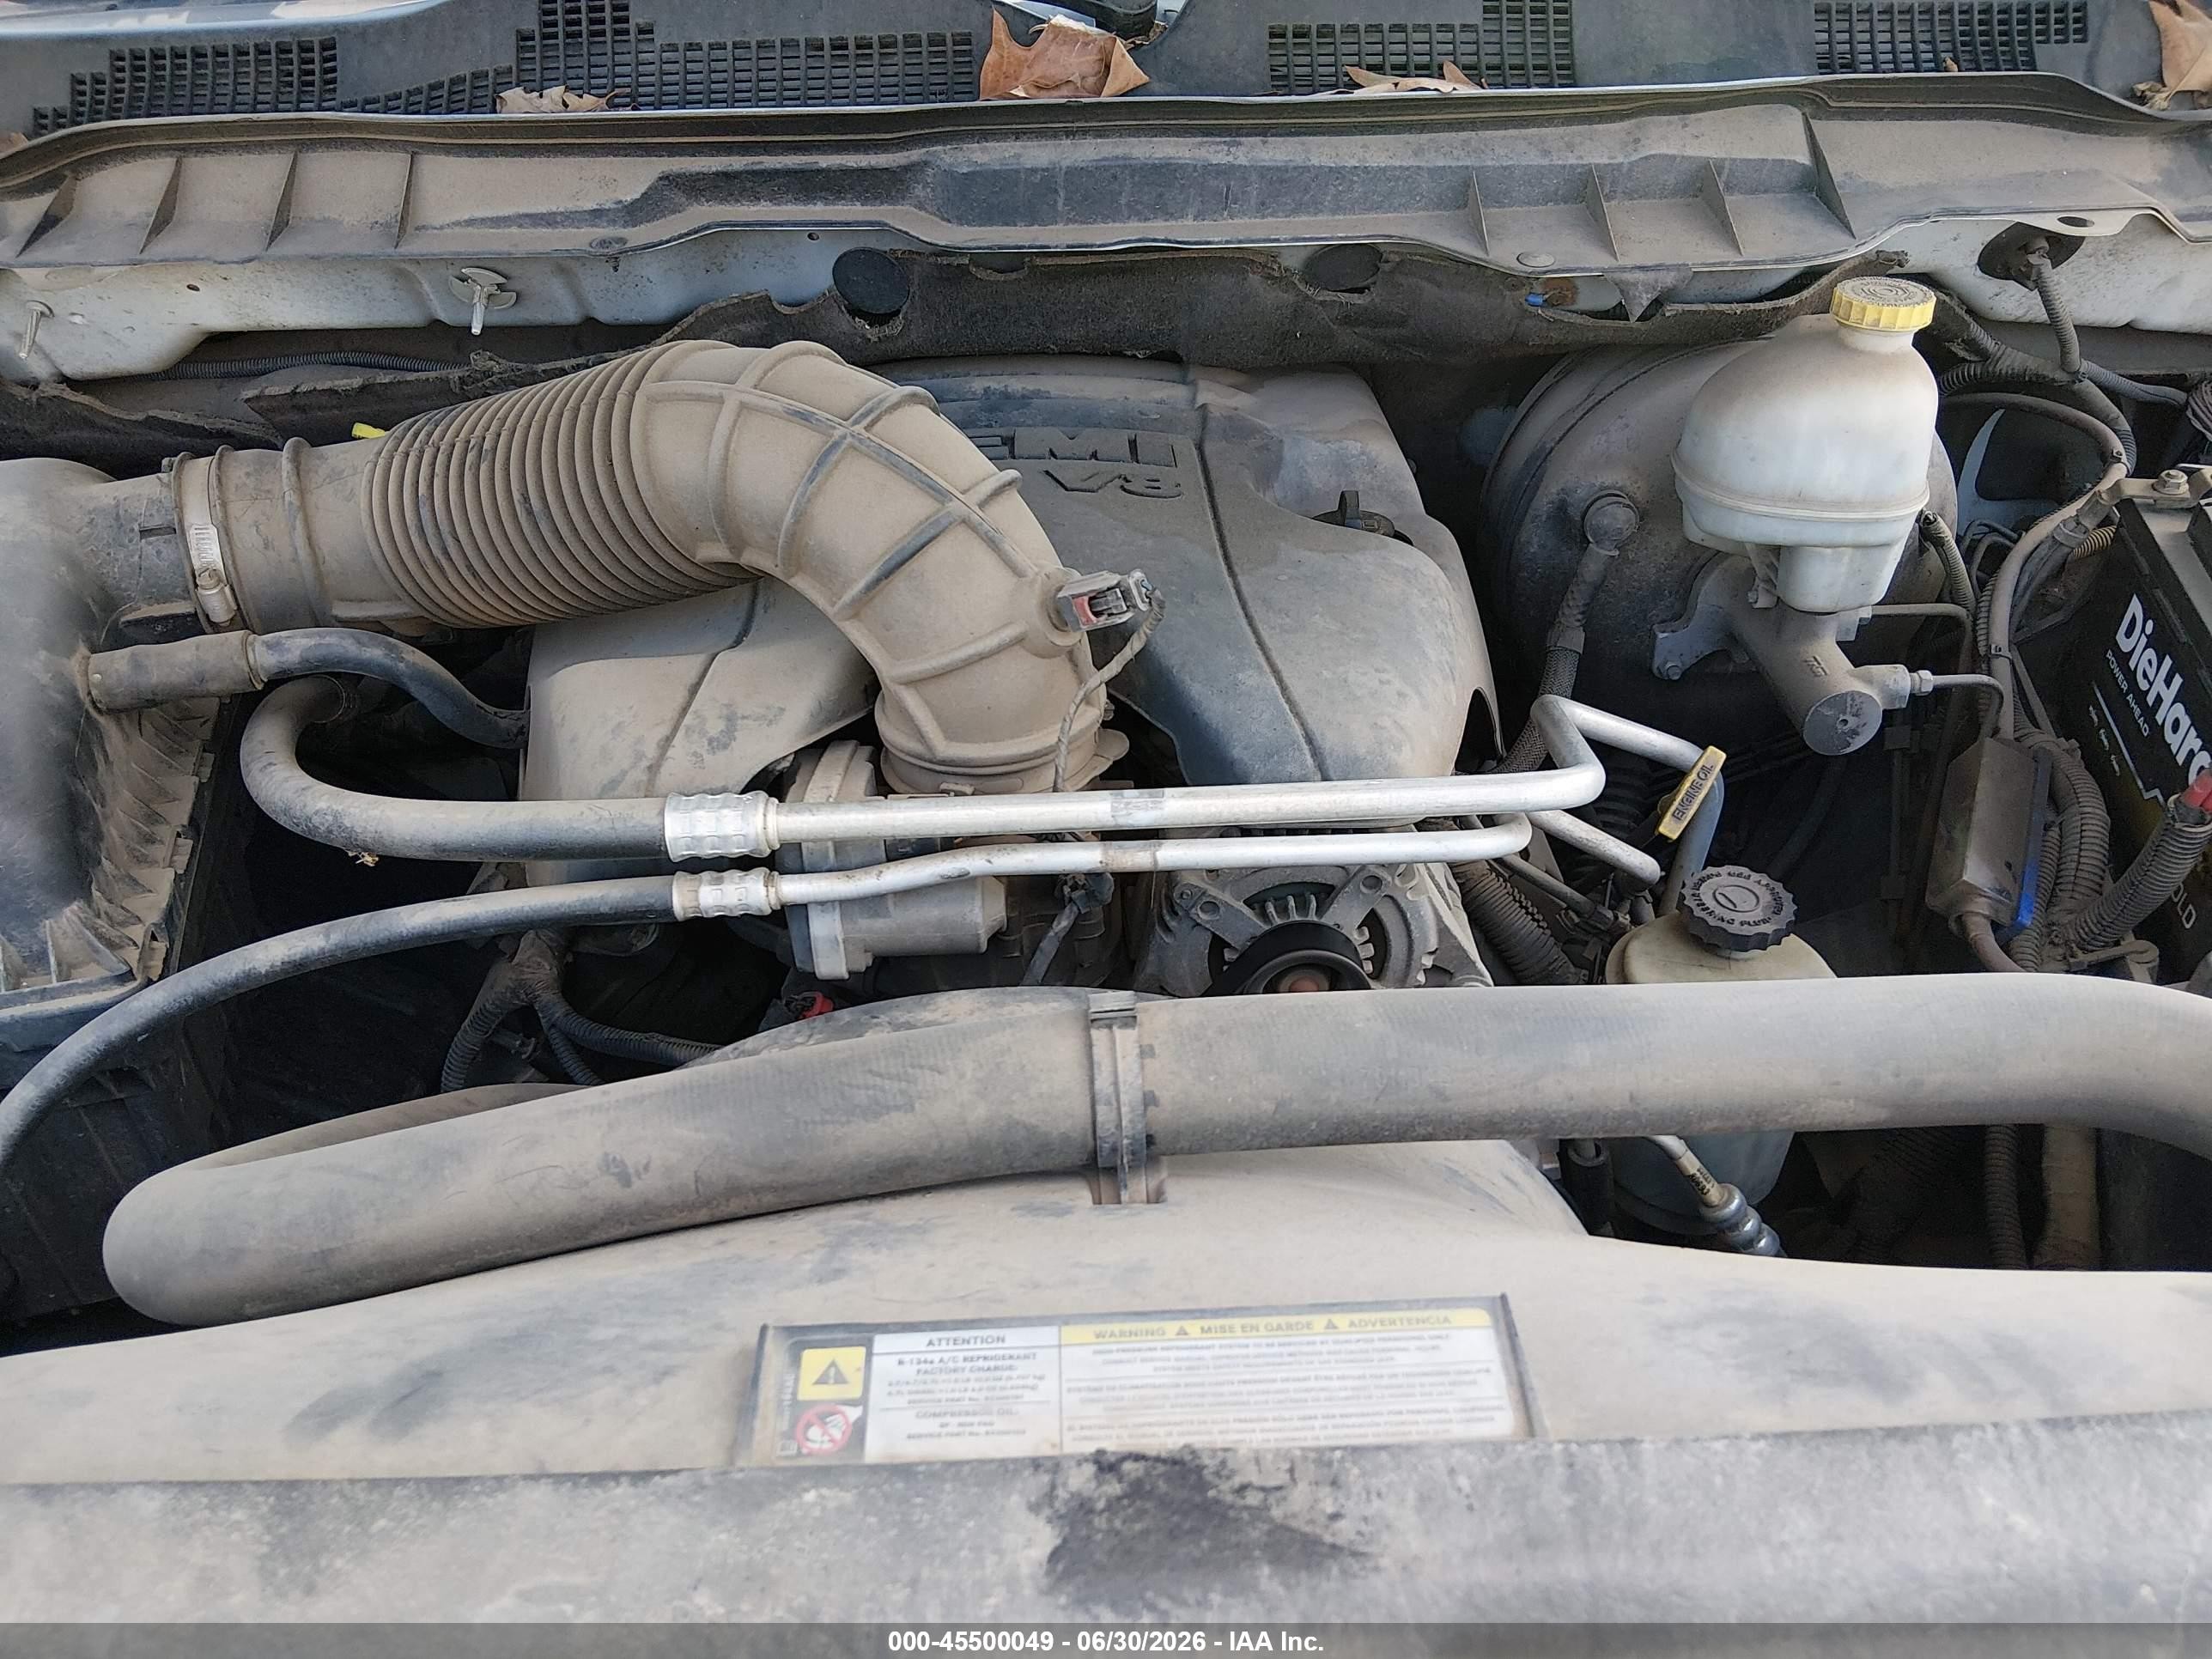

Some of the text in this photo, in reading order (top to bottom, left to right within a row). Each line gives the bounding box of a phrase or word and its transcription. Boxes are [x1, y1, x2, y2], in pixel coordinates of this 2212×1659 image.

[1042, 470, 1183, 499] V8
[2106, 648, 2149, 738] POWER AHEAD
[1672, 765, 1714, 821] ENGINE OIL
[927, 1334, 1006, 1347] ATTENTION
[1093, 1315, 1452, 1340] WARNING MISE EN GARDE ADVERTENCIA
[938, 1355, 960, 1364] A/C
[963, 1352, 1038, 1363] REFRIGERANT
